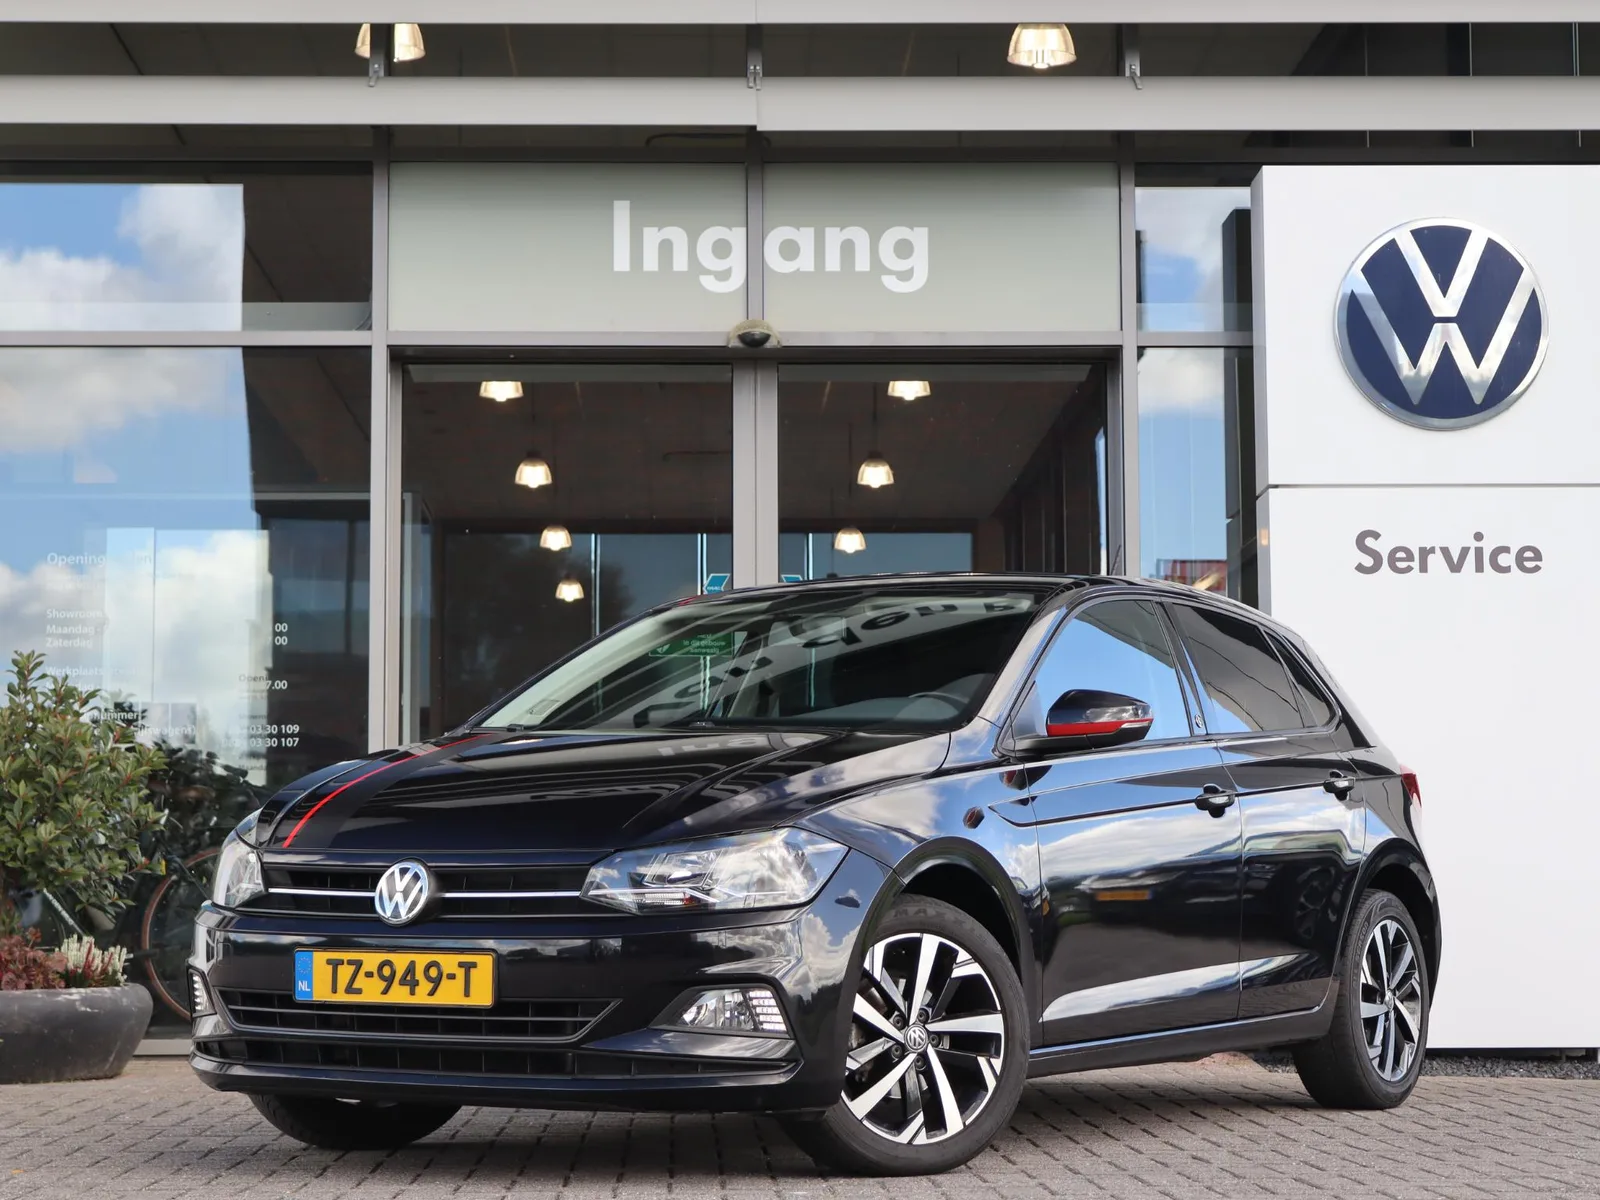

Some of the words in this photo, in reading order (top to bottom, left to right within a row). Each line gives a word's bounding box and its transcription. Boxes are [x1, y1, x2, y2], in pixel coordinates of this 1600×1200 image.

[613, 200, 929, 293] Ingang
[1354, 529, 1543, 574] Service
[46, 624, 95, 636] Maandag
[46, 637, 93, 650] Zaterdag
[265, 725, 278, 734] 30
[281, 725, 300, 734] 109
[265, 738, 278, 747] 30
[281, 738, 300, 747] 107
[326, 958, 478, 998] TZ-949-T
[298, 981, 311, 992] NL
